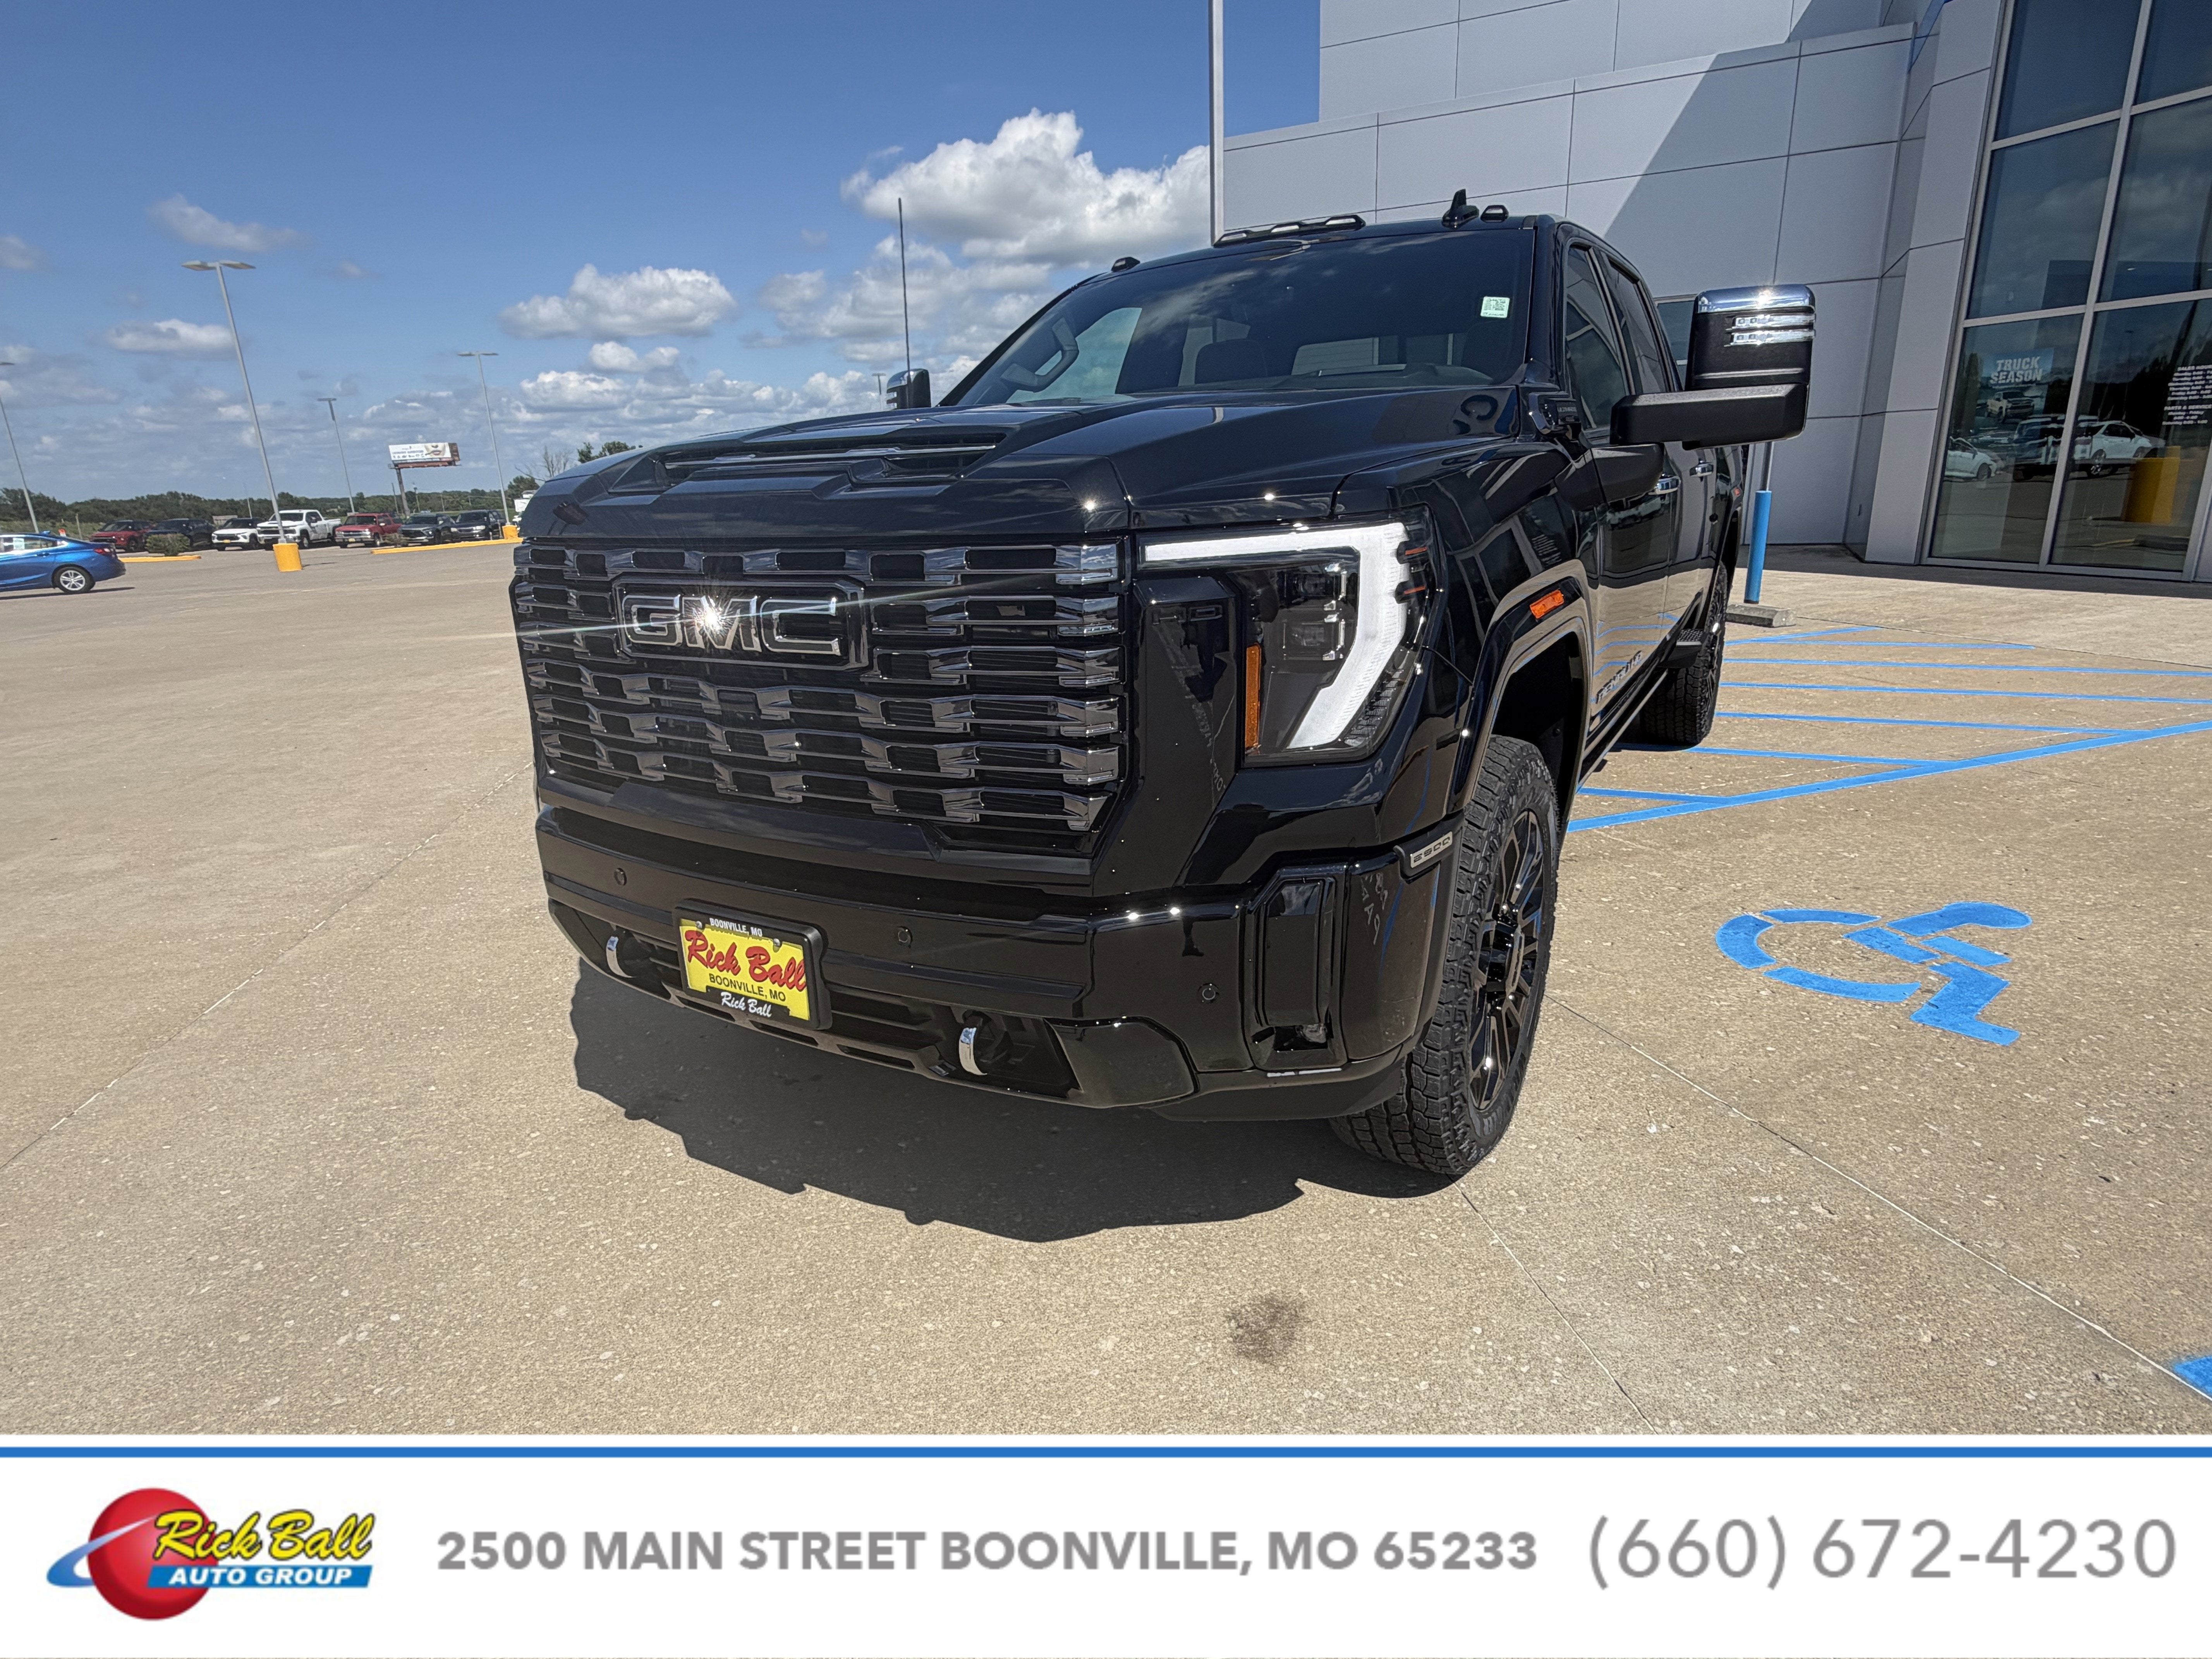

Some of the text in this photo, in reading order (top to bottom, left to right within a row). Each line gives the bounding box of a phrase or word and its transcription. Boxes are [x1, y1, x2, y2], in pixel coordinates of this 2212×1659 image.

[1989, 368, 2043, 384] SEASON
[1996, 356, 2041, 371] TRUCK
[622, 593, 842, 657] GMC
[709, 917, 763, 937] BOONVILLE, MO
[685, 929, 807, 992] Rick Ball
[709, 973, 786, 1002] BOONVILLE, MO
[720, 991, 772, 1018] Rick Ball
